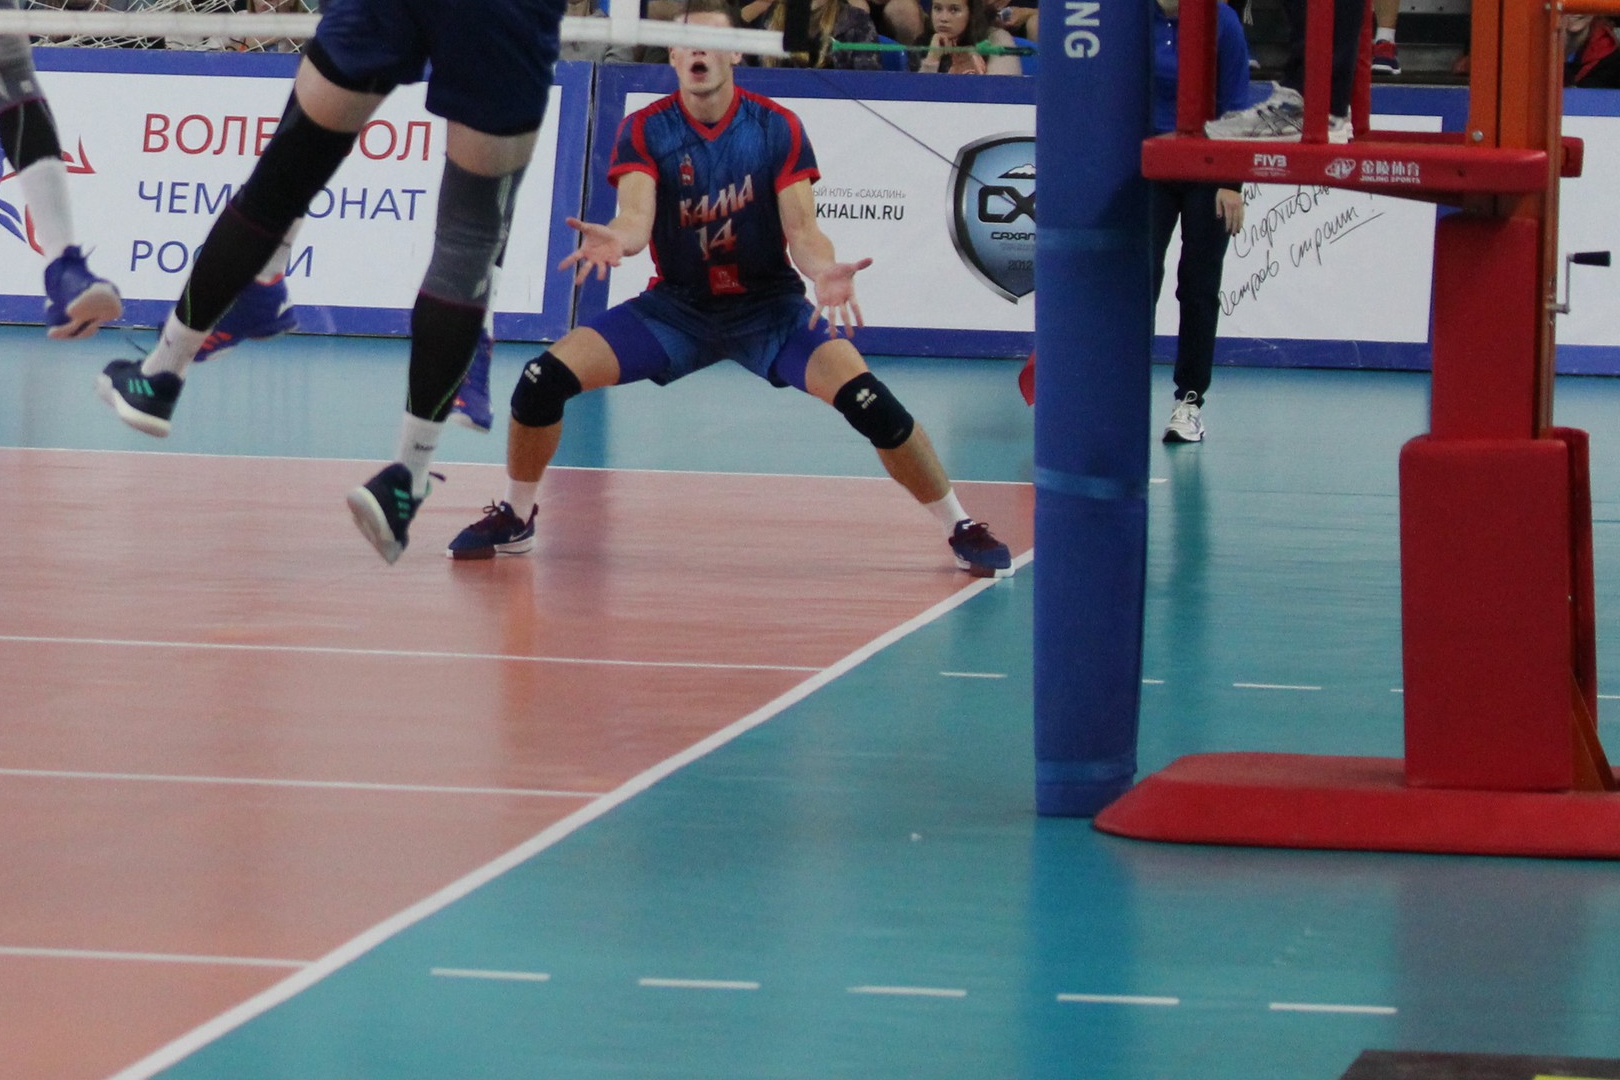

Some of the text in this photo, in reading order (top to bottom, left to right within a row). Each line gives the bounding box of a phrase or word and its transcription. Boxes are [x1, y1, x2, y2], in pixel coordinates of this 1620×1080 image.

[143, 113, 432, 161] ВОЛЕОЛ
[1253, 153, 1288, 168] FIVB
[137, 181, 427, 221] ЧЕМОНАТ
[815, 203, 905, 221] KHALIN.RU
[829, 187, 853, 198] КЛУБ
[694, 218, 737, 261] 14
[130, 240, 315, 279] РОИ
